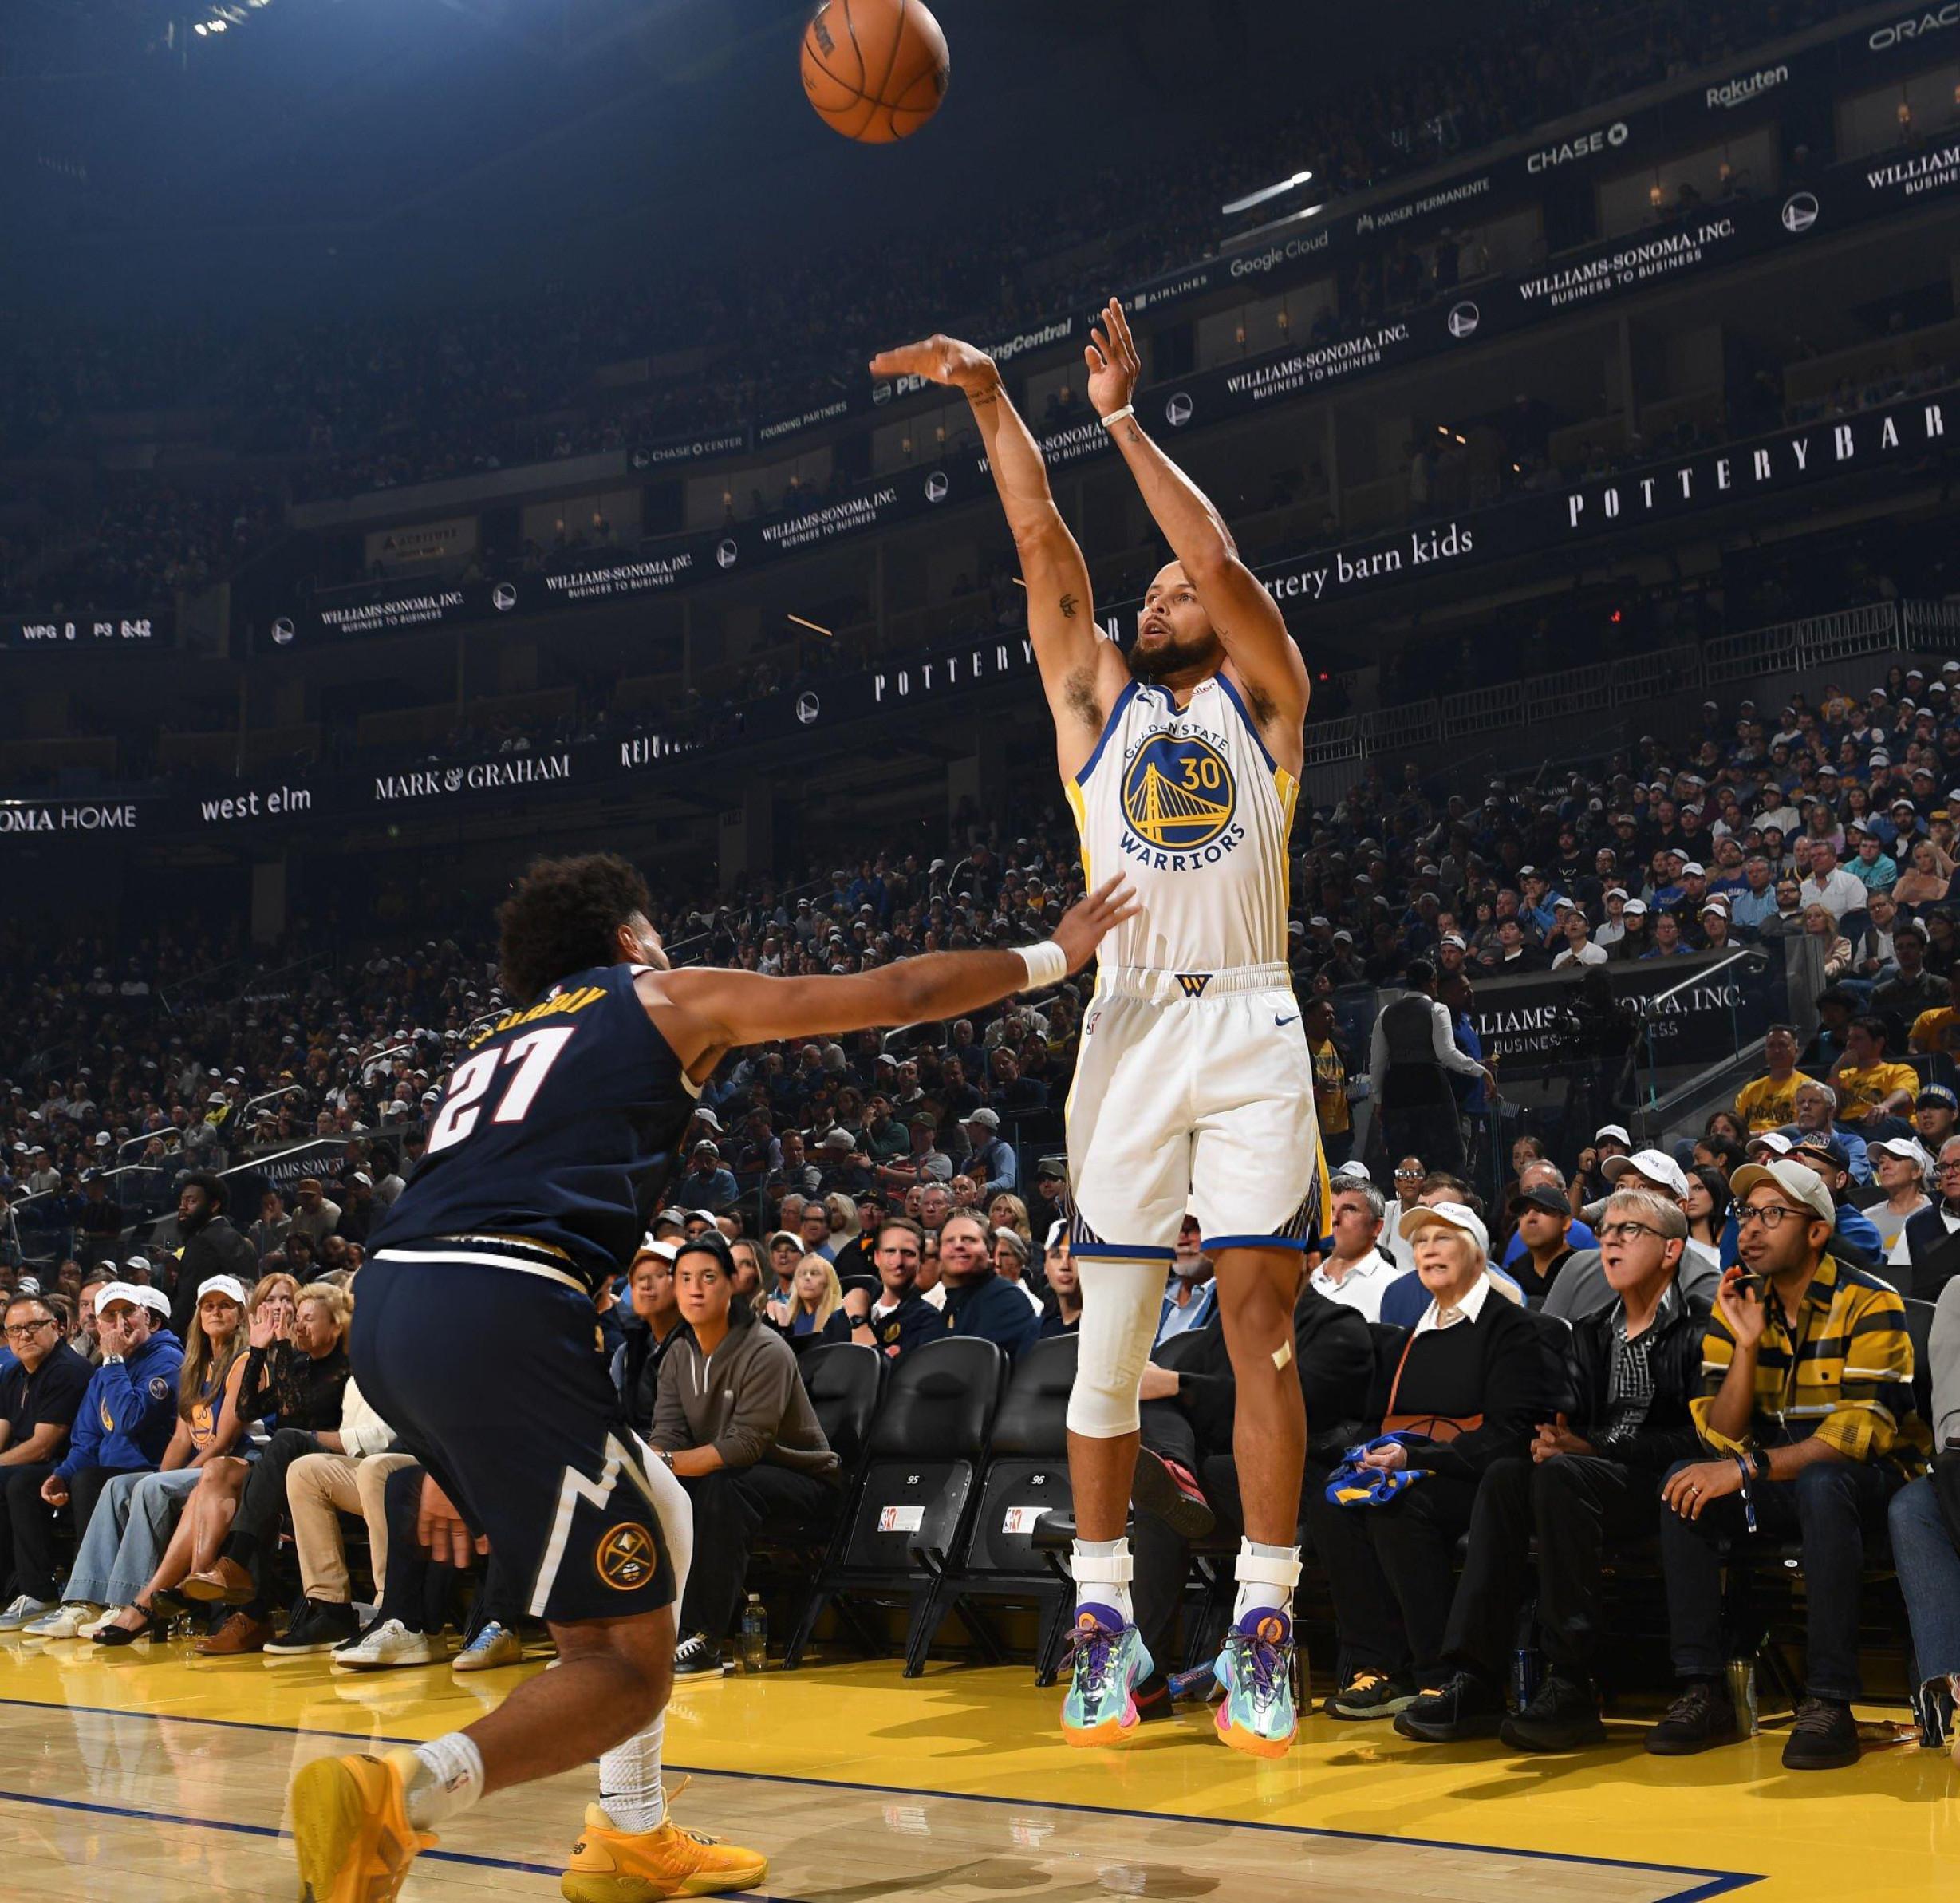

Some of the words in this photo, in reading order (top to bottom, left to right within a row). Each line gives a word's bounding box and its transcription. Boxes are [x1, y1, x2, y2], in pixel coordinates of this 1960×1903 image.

[1706, 65, 1789, 109] Rakuten
[1526, 132, 1604, 174] CHASE
[1376, 203, 1414, 228] KAISER
[1414, 176, 1490, 217] PERMANENTE
[1230, 247, 1284, 278] Google
[1285, 231, 1328, 259] Cloud
[1519, 231, 1697, 301] WILLIAMS-SONOMA,
[1698, 217, 1736, 244] INC.
[1148, 274, 1208, 305] AIRLINES
[1550, 275, 1611, 306] BUSINESS
[1615, 267, 1635, 285] TO
[1638, 247, 1703, 278] BUSINESS
[1226, 333, 1377, 396] WILLIAMS-SONOMA,
[1378, 322, 1410, 349] INC.
[1252, 376, 1305, 401] BUSINESS
[1306, 368, 1324, 383] TO
[1327, 350, 1382, 377] BUSINESS
[760, 415, 801, 440] FOUNDING
[803, 400, 848, 424] PARTNERS
[652, 445, 691, 462] CHASE
[704, 436, 743, 452] CENTER
[1047, 449, 1061, 464] TO
[1063, 436, 1110, 461] BUSINESS
[1568, 438, 1811, 529] POTTERY
[781, 525, 821, 550] BUSINESS
[822, 521, 835, 536] TO
[836, 510, 877, 535] BUSINESS
[1335, 543, 1402, 586] barn
[1410, 521, 1474, 563] kids
[567, 582, 613, 599] BUSINESS
[613, 579, 629, 592] TO
[629, 573, 675, 590] BUSINESS
[22, 624, 57, 640] WPG
[65, 622, 76, 640] 0
[341, 618, 384, 634] BUSINESS
[385, 614, 399, 626] TO
[400, 609, 442, 625] BUSINESS
[874, 639, 1034, 702] POTTERY
[1182, 724, 1229, 752] STATE
[373, 769, 441, 802] MARK
[443, 767, 465, 792] &
[467, 753, 571, 790] GRAHAM
[1178, 757, 1221, 792] 30
[61, 804, 137, 831] HOME
[201, 790, 260, 823] west
[266, 786, 312, 813] elm
[1119, 823, 1245, 872] WARRIORS
[1692, 985, 1746, 1011] INC.
[424, 1025, 578, 1155] 27
[906, 1475, 920, 1485] 95
[1031, 1475, 1045, 1485] 96
